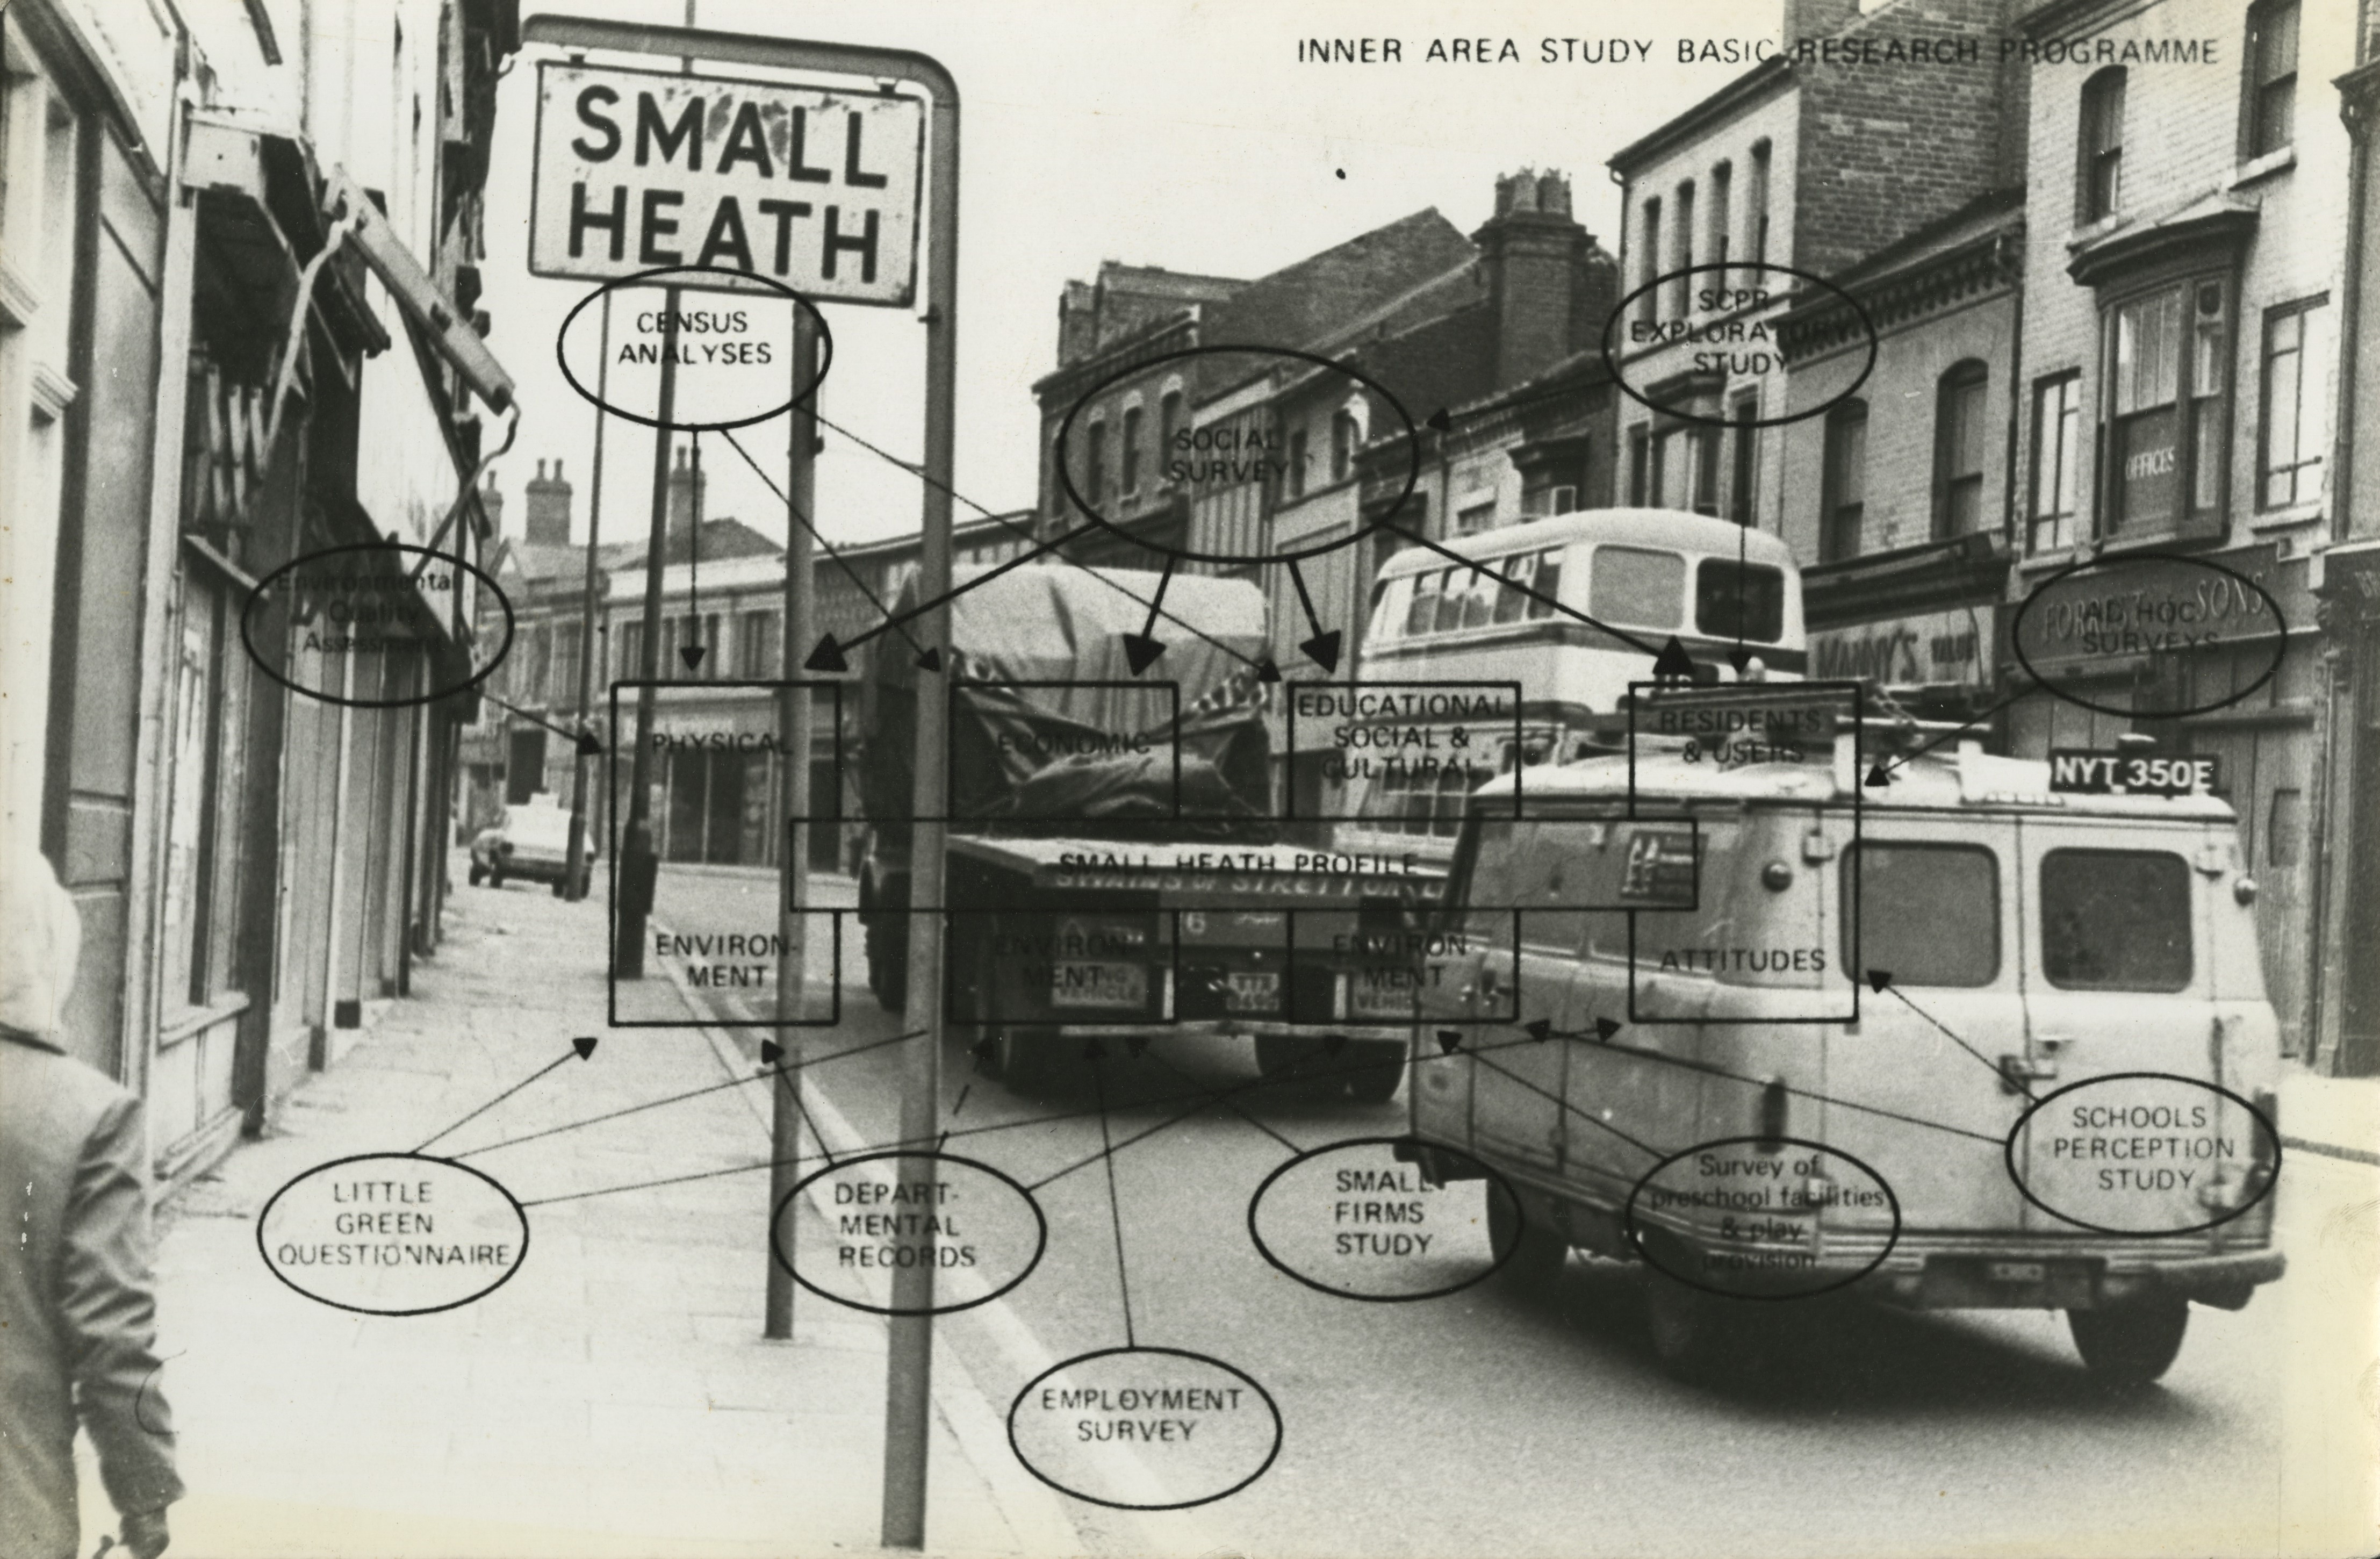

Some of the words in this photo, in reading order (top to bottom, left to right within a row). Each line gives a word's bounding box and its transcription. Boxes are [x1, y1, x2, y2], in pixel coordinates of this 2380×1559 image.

[571, 84, 887, 188] SMALL
[568, 181, 880, 283] HEATH
[2126, 446, 2175, 480] OFFICES
[2196, 572, 2263, 621] SONS
[2055, 756, 2120, 786] NYT
[2126, 759, 2213, 790] 350E
